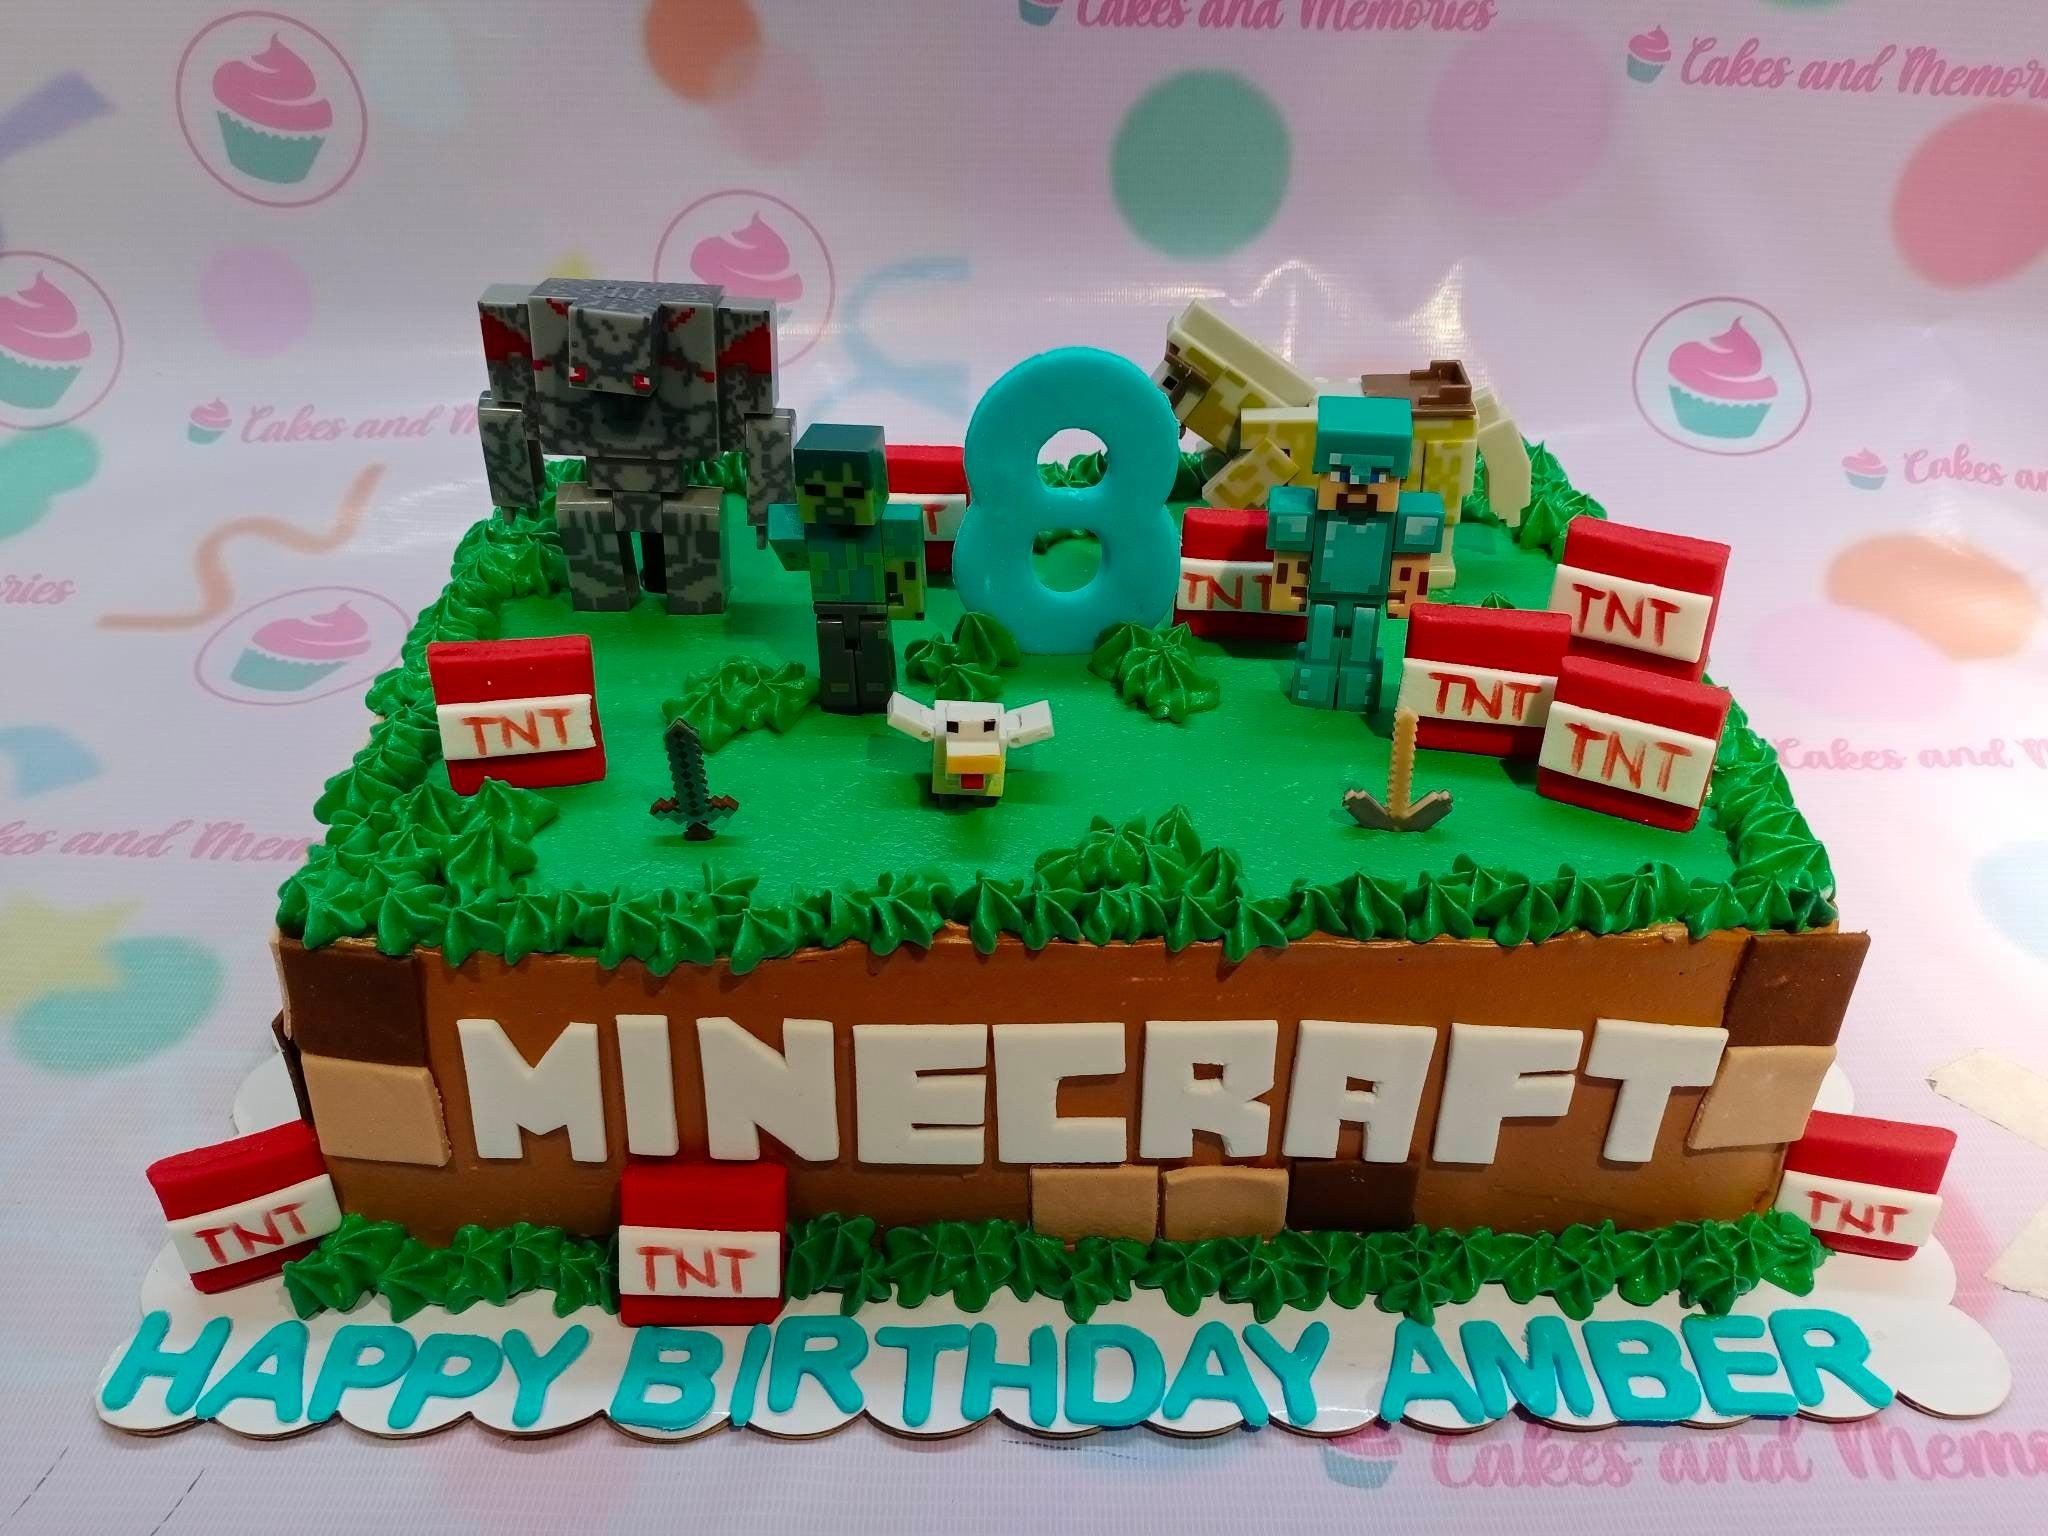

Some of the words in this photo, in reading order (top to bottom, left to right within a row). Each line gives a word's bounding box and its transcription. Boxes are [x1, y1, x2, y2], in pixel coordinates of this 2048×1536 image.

[1681, 37, 1793, 89] Cakes
[1797, 44, 1897, 93] and
[241, 404, 347, 443] Cakes
[353, 404, 445, 438] and
[1903, 443, 2007, 486] Cakes
[953, 346, 1181, 655] 8
[1573, 583, 1681, 647] TNT
[1428, 672, 1542, 721] TNT
[460, 707, 573, 756] TNT
[1564, 721, 1694, 793] TNT
[1774, 738, 1907, 770] Cakes
[1918, 738, 2014, 769] and
[60, 819, 194, 858] and
[456, 1014, 1729, 1166] MINECRAFT
[192, 1202, 308, 1265] TNT
[1806, 1190, 1912, 1235] TNT
[636, 1246, 757, 1294] TNT
[98, 1309, 594, 1429] HAPPY
[608, 1313, 1330, 1428] BIRTHDAY
[1379, 1307, 1899, 1426] AMBER
[1431, 1422, 1642, 1488] Cakes
[1658, 1416, 1814, 1484] and
